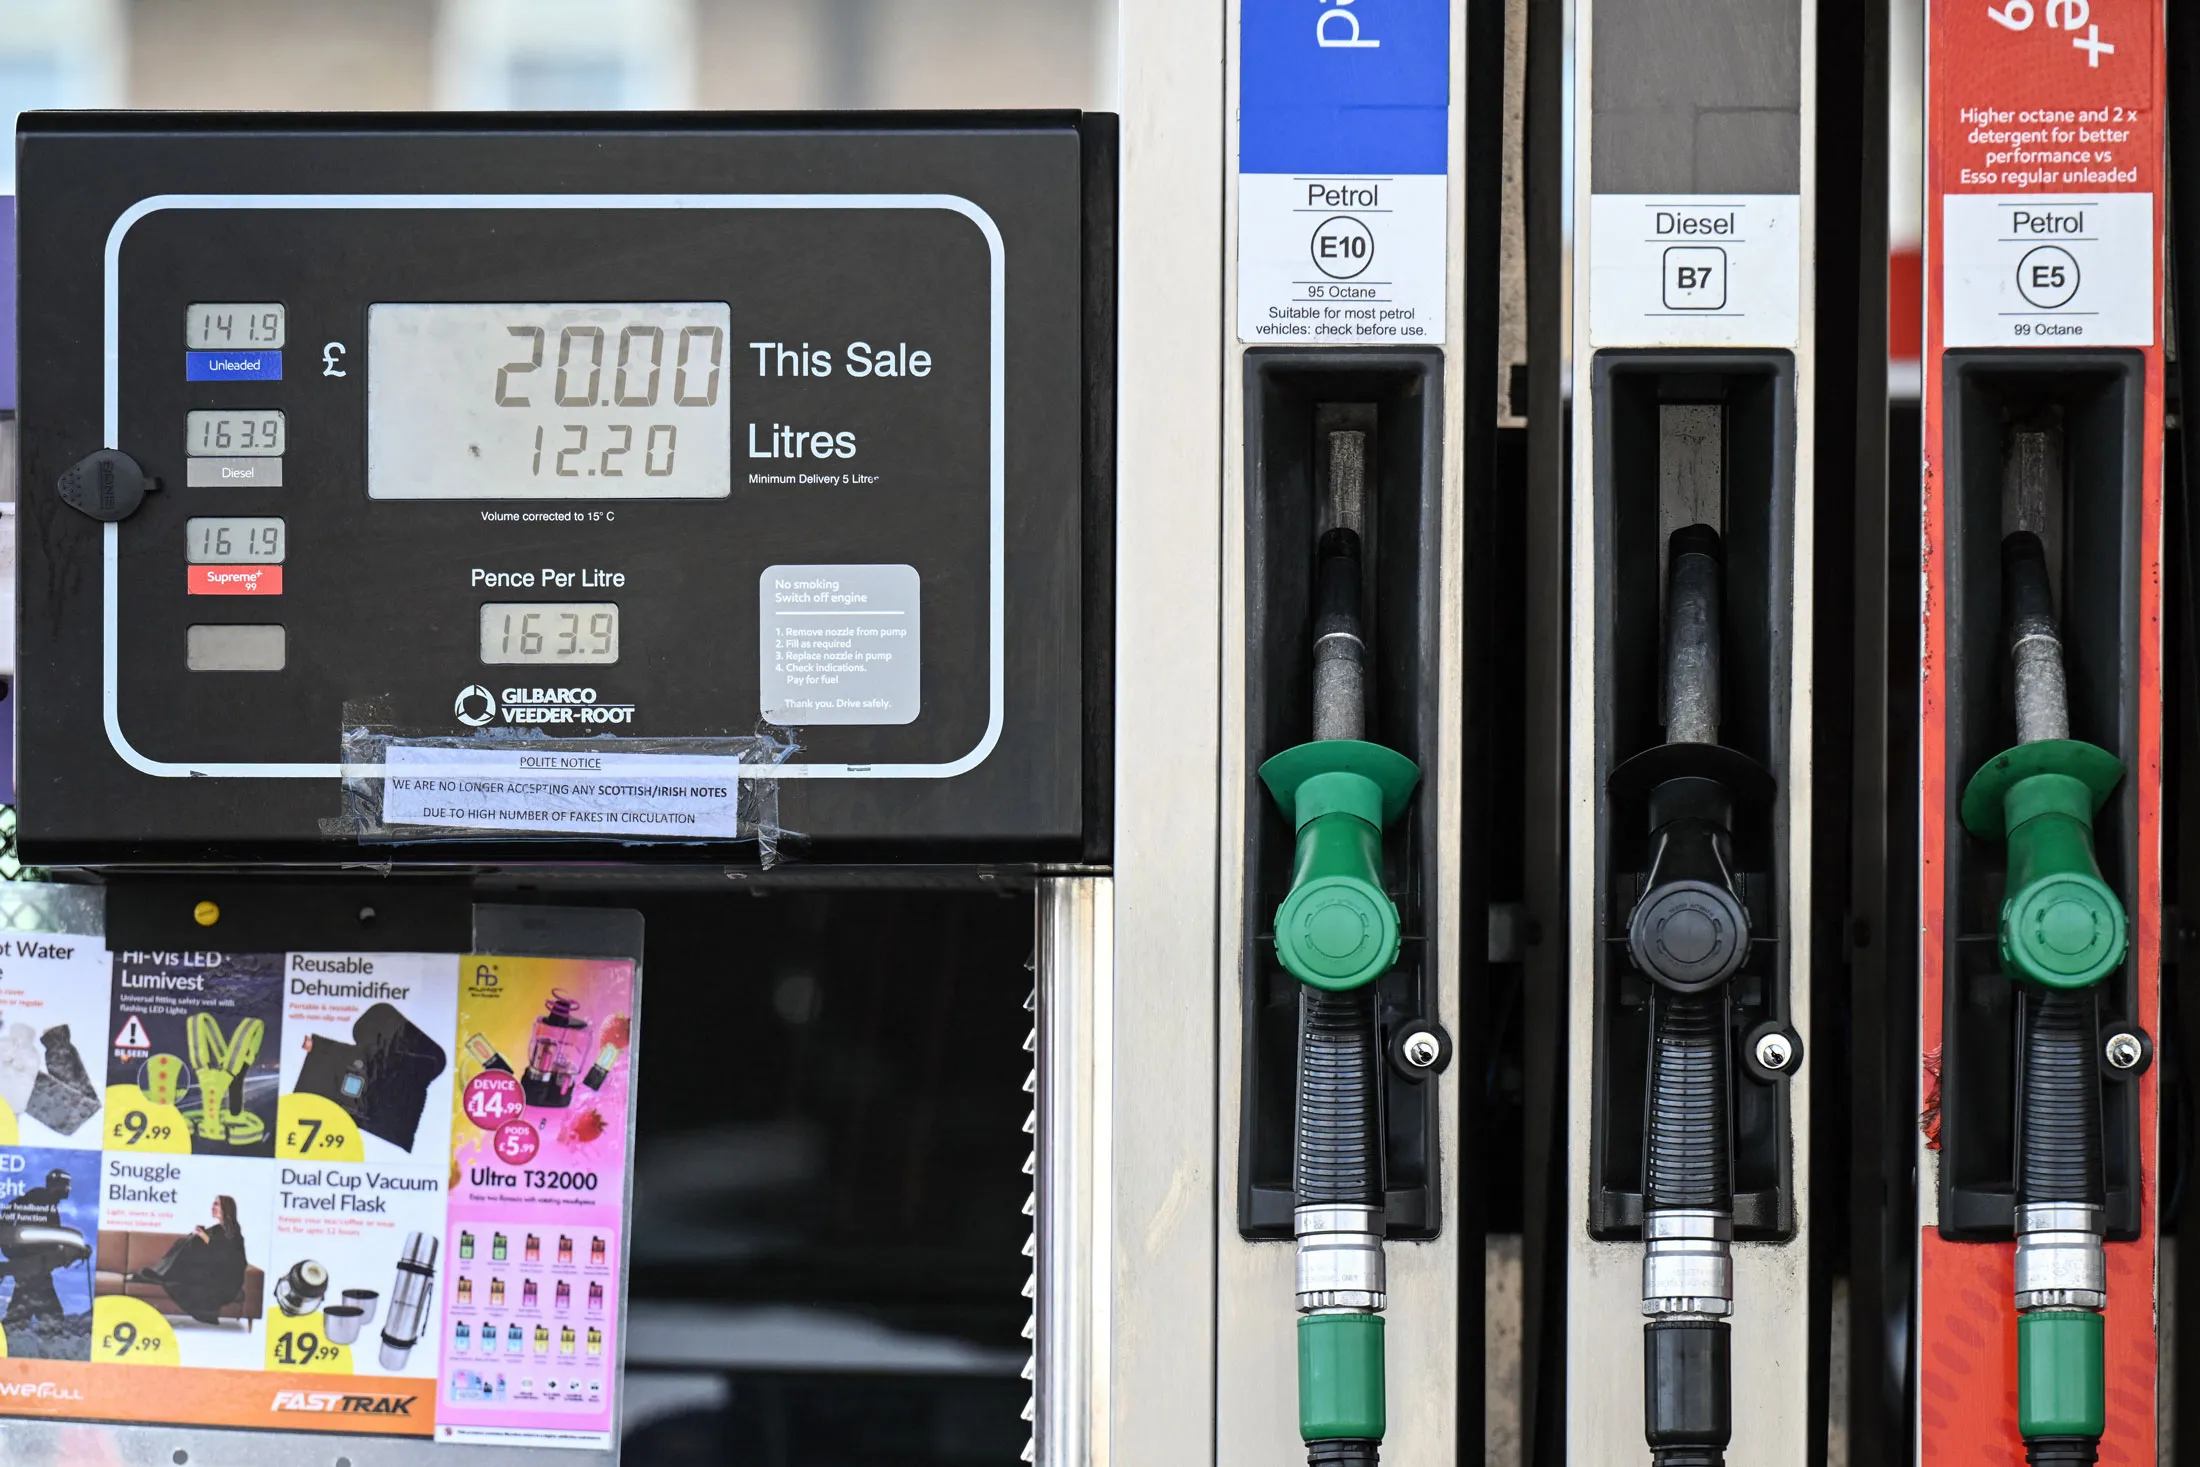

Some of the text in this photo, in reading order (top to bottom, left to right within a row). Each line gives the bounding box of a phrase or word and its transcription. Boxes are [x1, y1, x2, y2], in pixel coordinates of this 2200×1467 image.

[1961, 108, 2137, 126] Higher octane and 2 x
[1969, 128, 2129, 147] detergent for better
[1986, 149, 2112, 166] performance vs
[1961, 169, 2137, 187] Esso regular unleaded
[1308, 184, 1378, 206] Petrol
[1656, 212, 1734, 234] Diesel
[2013, 212, 2084, 233] Petrol
[1320, 236, 1366, 258] E10
[1678, 267, 1711, 288] B7
[2032, 267, 2065, 287] E5
[1308, 287, 1375, 298] 95 Octane
[1269, 307, 1415, 323] Suitable for most petrol
[203, 313, 278, 342] 141.9
[1256, 324, 1427, 336] vehicles: check before use.
[2014, 324, 2082, 336] 99 Octane
[209, 360, 260, 371] Unleaded
[322, 342, 346, 377] £
[495, 326, 723, 408] 20.00
[750, 342, 932, 377] This Sale
[203, 420, 278, 448] 163.9
[749, 423, 856, 458] Litres
[532, 425, 677, 477] 12.20
[222, 467, 254, 478] Diesel
[749, 474, 795, 483] Minimum
[799, 474, 840, 486] Delivery
[843, 475, 848, 483] 5
[481, 512, 519, 520] Volume
[523, 512, 572, 520] corrected
[574, 512, 584, 520] to
[607, 512, 614, 521] C
[203, 527, 278, 555] 161.9
[472, 569, 625, 587] Pence Per Litre
[775, 579, 839, 591] No smoking
[775, 593, 867, 605] Switch off engine
[502, 614, 613, 654] 163.9
[776, 628, 907, 638] 1. Remove nozzle from pump
[776, 640, 783, 648] 2.
[786, 639, 799, 647] Fill
[813, 639, 851, 650] required
[776, 652, 783, 660] 3.
[786, 652, 821, 662] Replace
[824, 651, 852, 660] nozzle
[855, 651, 863, 660] in
[775, 663, 867, 672] 4. Check indications.
[787, 675, 838, 685] Pay for fuel
[502, 688, 596, 703] GILBARCO
[785, 699, 891, 709] Thank you. Drive safely.
[502, 708, 635, 723] VEEDER-ROOT
[520, 757, 601, 768] POLITE NOTICE
[393, 779, 411, 790] WE
[414, 780, 435, 791] ARE
[439, 780, 456, 792] NO
[459, 781, 503, 793] LONGER
[572, 785, 595, 795] ANY
[599, 785, 687, 798] SCOTTISH/IRISH
[690, 786, 727, 798] NOTES
[423, 808, 695, 824] DUE TO HIGH NUMBER OF FAKES IN CIRCULATION
[17, 941, 74, 959] Water
[184, 951, 222, 967] LED
[292, 955, 373, 974] Reusable
[122, 970, 204, 991] Lumivest
[291, 979, 410, 1000] Dehumidifier
[120, 1004, 147, 1013] flashing
[166, 1006, 187, 1015] Lights
[121, 994, 154, 1002] Universal
[155, 996, 176, 1005] fitting
[178, 996, 200, 1006] safety
[474, 1079, 515, 1091] DEVICE
[468, 1092, 522, 1118] £14.99
[114, 1110, 171, 1145] £9.99
[287, 1119, 344, 1152] £7.99
[505, 1126, 530, 1136] PODS
[500, 1136, 534, 1155] £5.99
[110, 1160, 180, 1180] Snuggle
[471, 1168, 598, 1190] Ultra T32000
[281, 1169, 438, 1191] Dual Cup Vacuum
[109, 1184, 177, 1203] Blanket
[280, 1192, 386, 1212] Travel Flask
[103, 1321, 161, 1356] £9.99
[274, 1332, 339, 1364] £19.99
